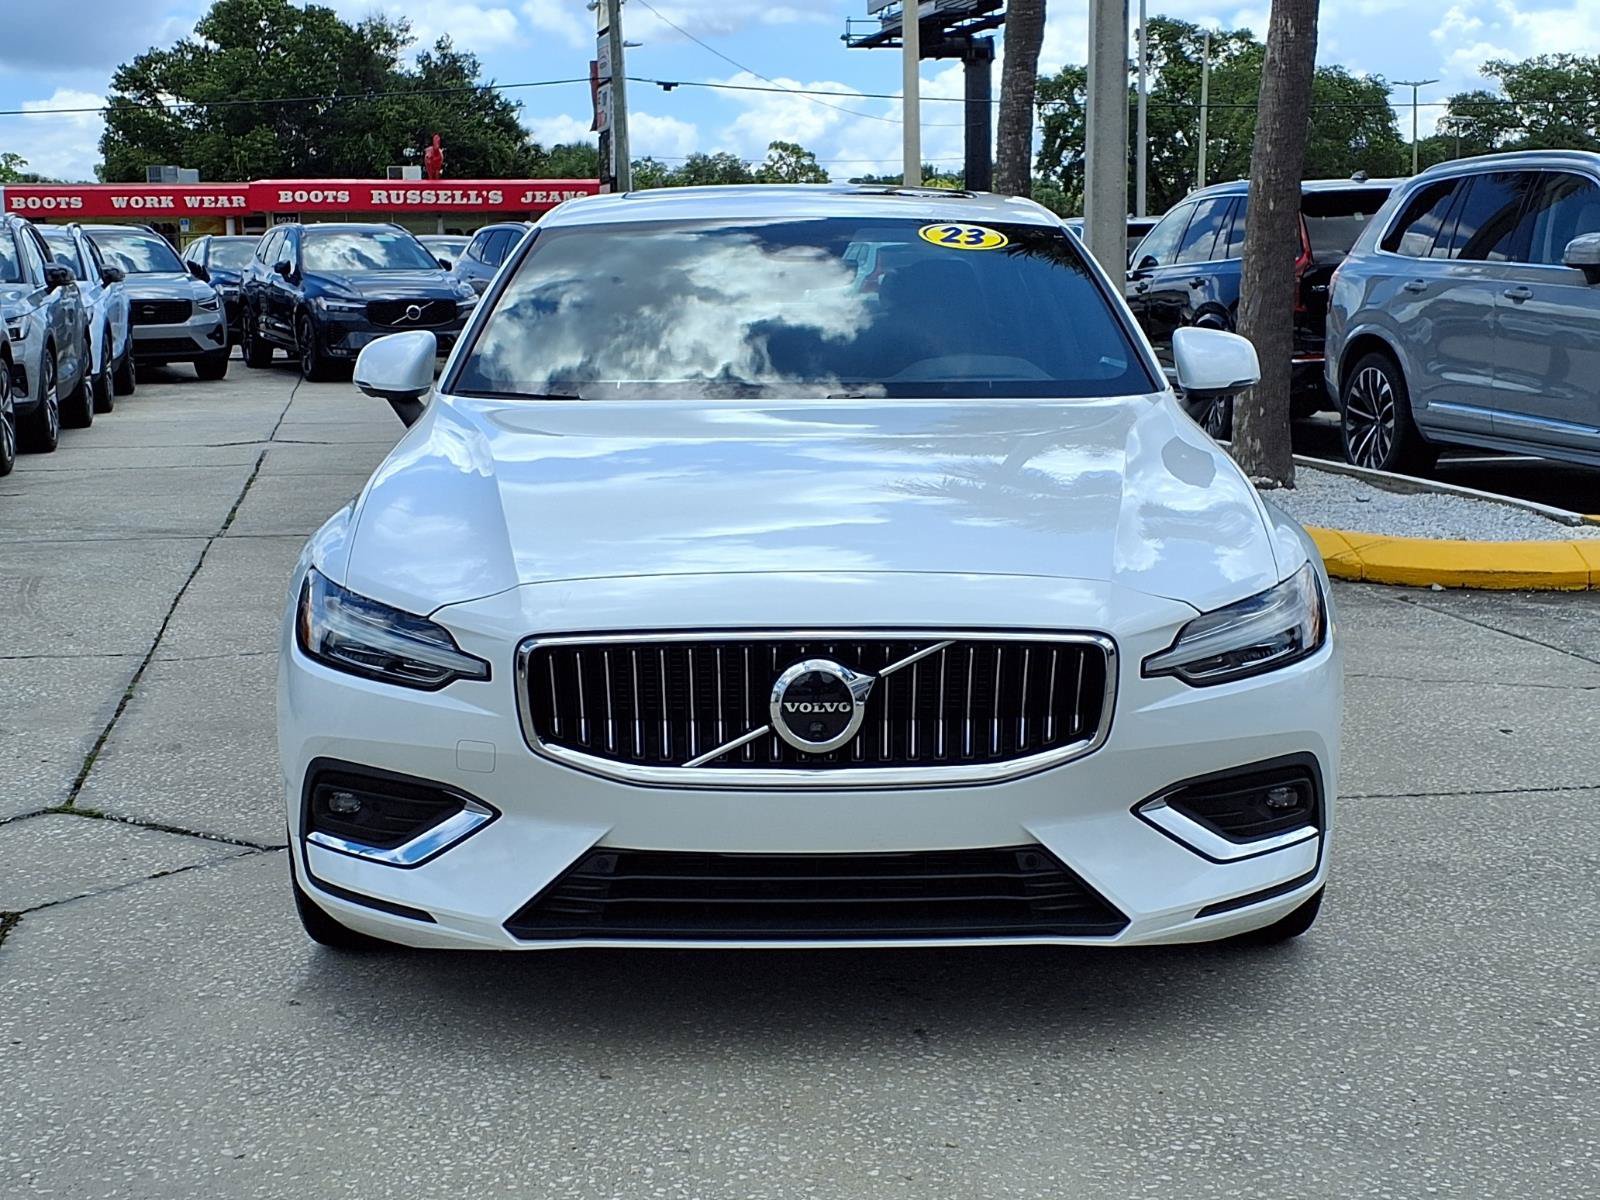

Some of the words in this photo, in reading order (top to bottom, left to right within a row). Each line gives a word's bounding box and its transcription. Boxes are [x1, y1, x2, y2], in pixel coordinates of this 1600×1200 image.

[10, 196, 83, 209] BOOTS
[110, 196, 175, 208] WORK
[184, 196, 246, 208] WEAR
[278, 190, 350, 203] BOOTS
[370, 190, 503, 204] RUSSELL'S
[940, 226, 985, 245] 23
[783, 702, 851, 713] VOLVO
